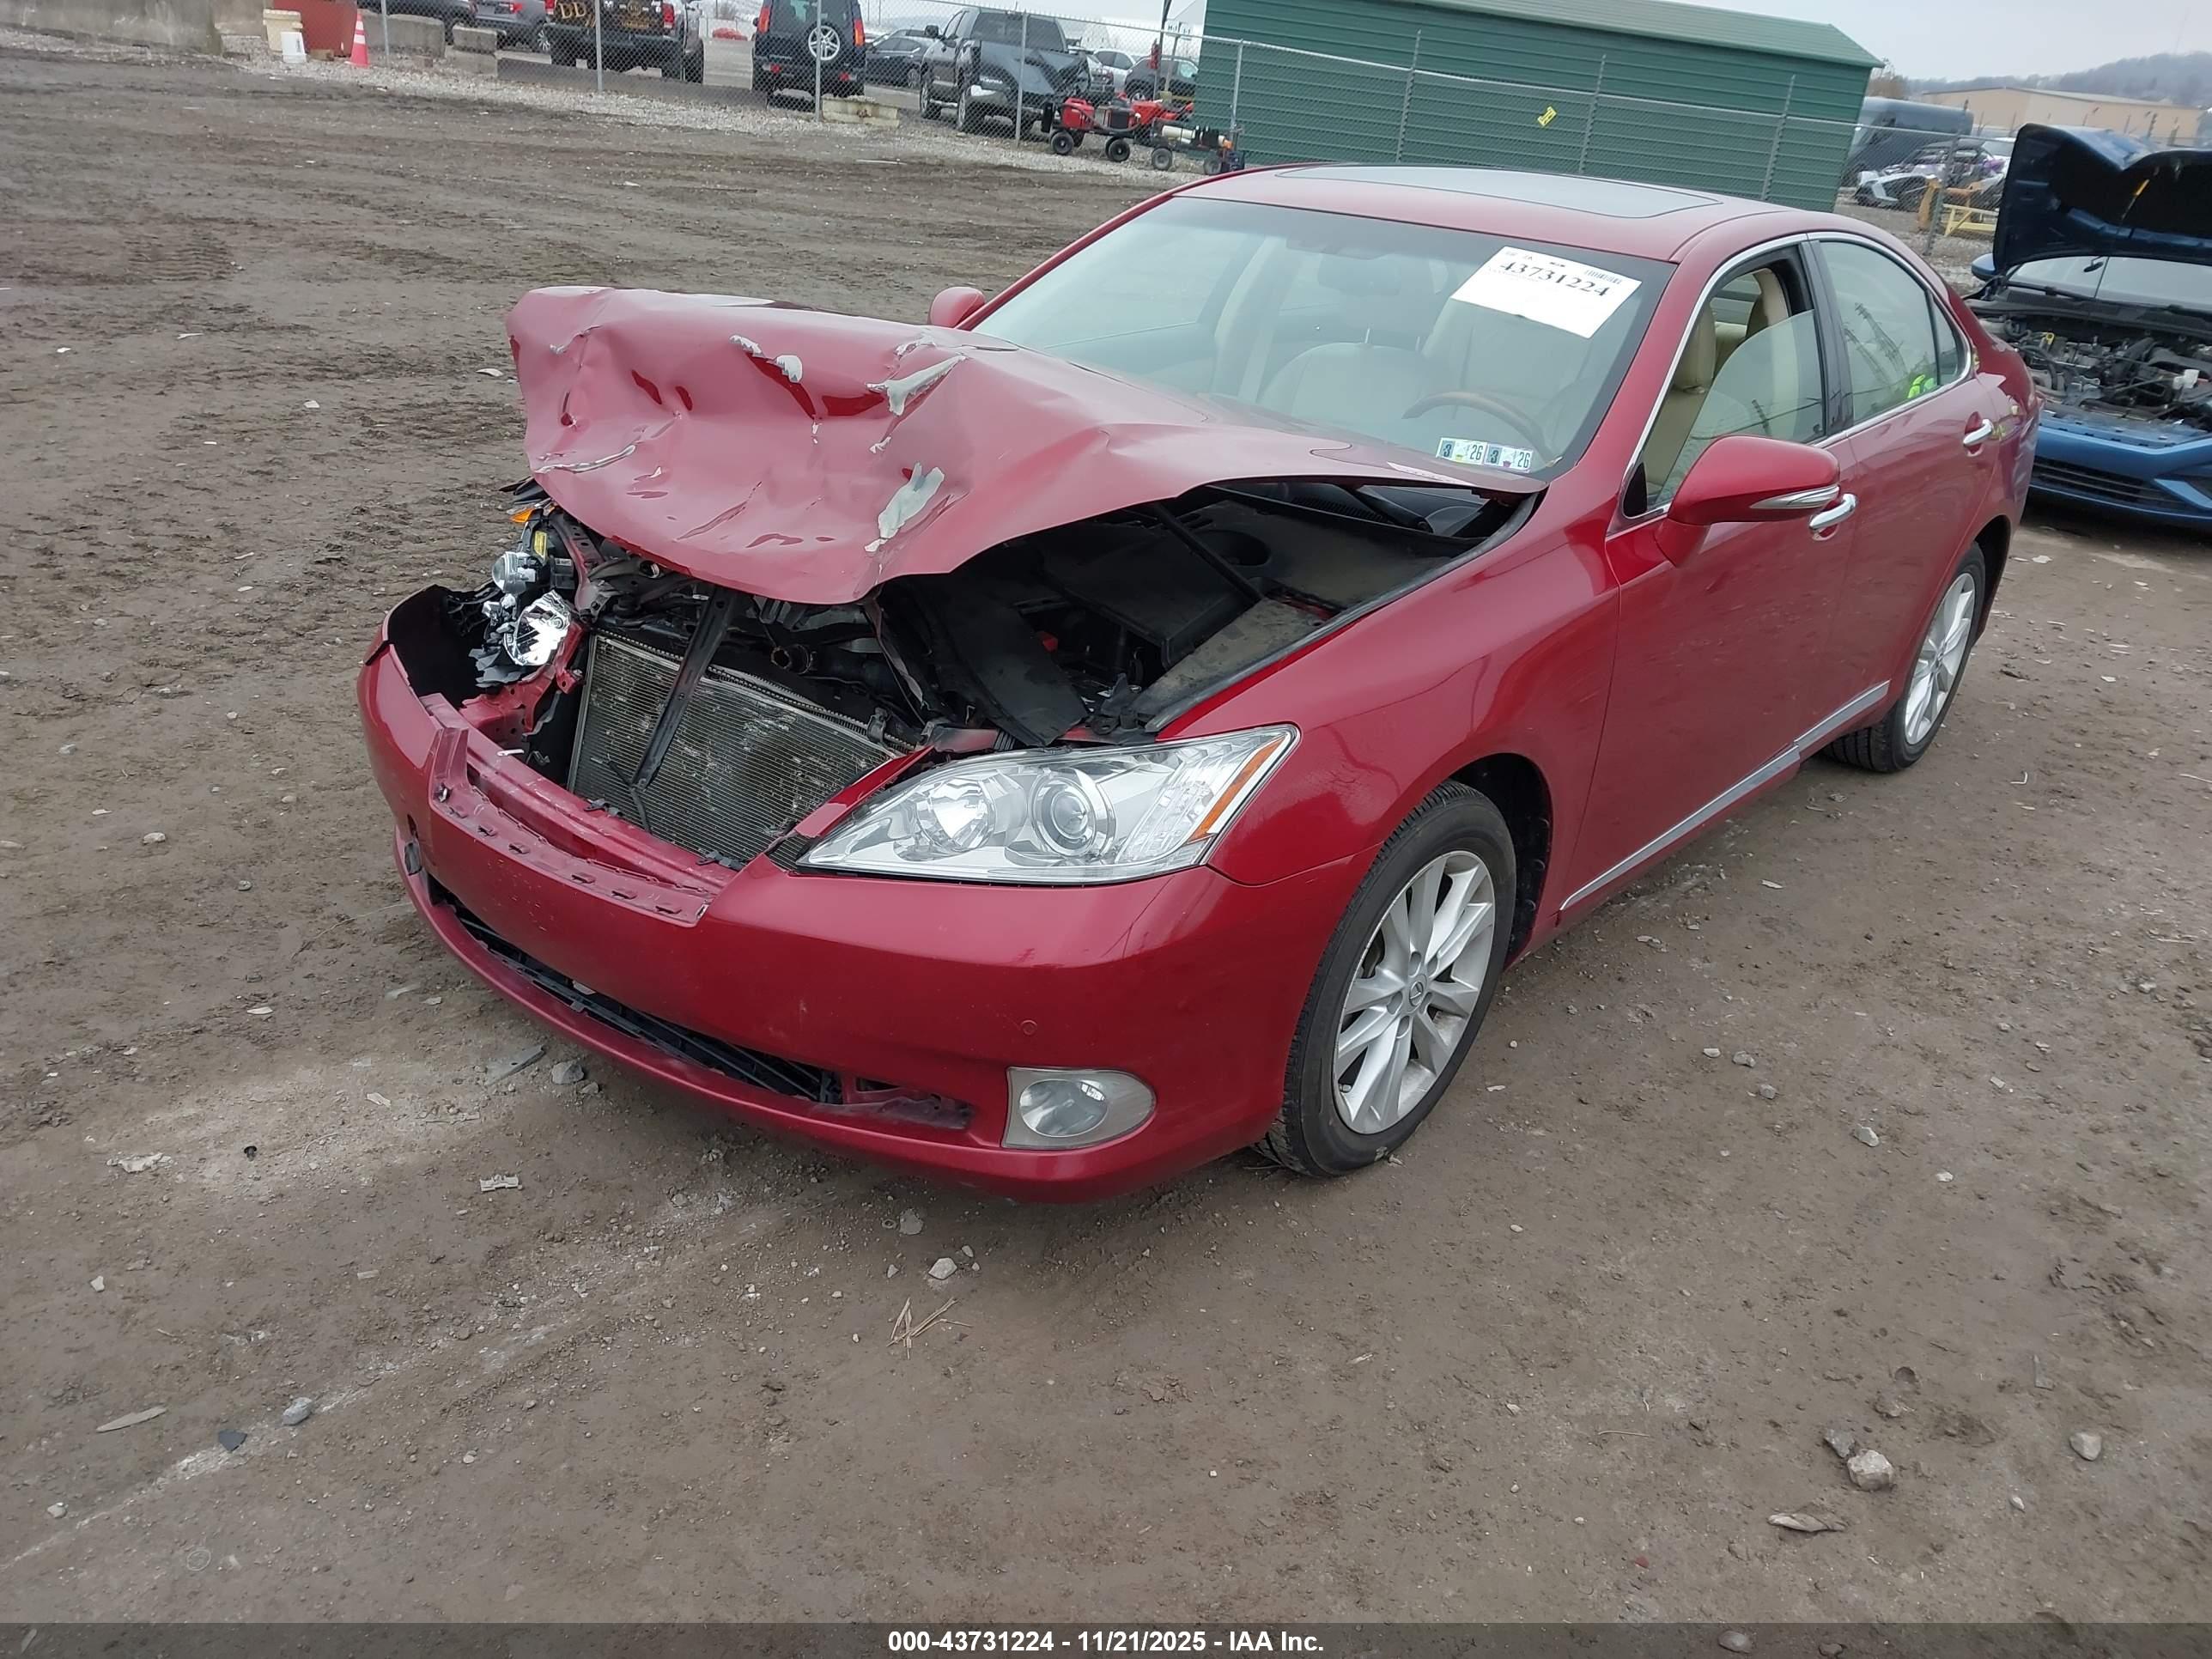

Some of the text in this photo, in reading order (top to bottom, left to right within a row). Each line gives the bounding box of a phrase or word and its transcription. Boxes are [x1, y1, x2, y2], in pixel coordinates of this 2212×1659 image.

[1500, 261, 1610, 296] 43731224
[1443, 443, 1484, 461] 3 26
[1490, 449, 1531, 468] 3 26
